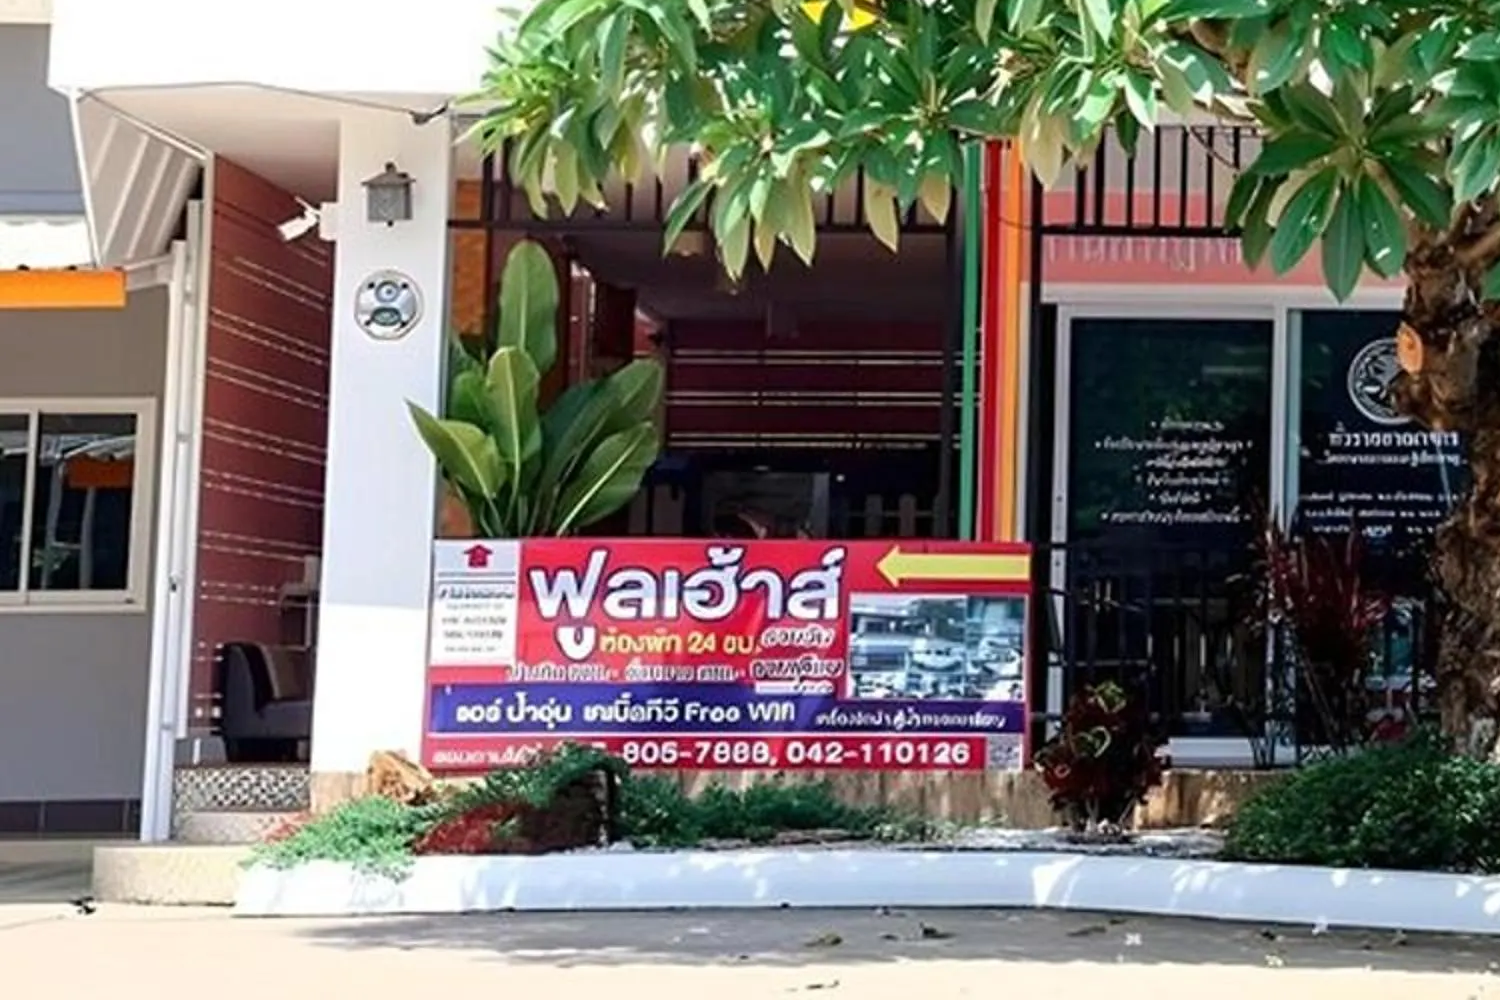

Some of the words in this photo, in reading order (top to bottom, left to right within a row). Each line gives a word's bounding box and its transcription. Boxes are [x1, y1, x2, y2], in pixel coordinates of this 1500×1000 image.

[528, 546, 846, 660] ฟูลเฮ้าส์
[688, 631, 716, 654] 24
[684, 702, 741, 722] Free
[786, 741, 971, 764] 042-110126
